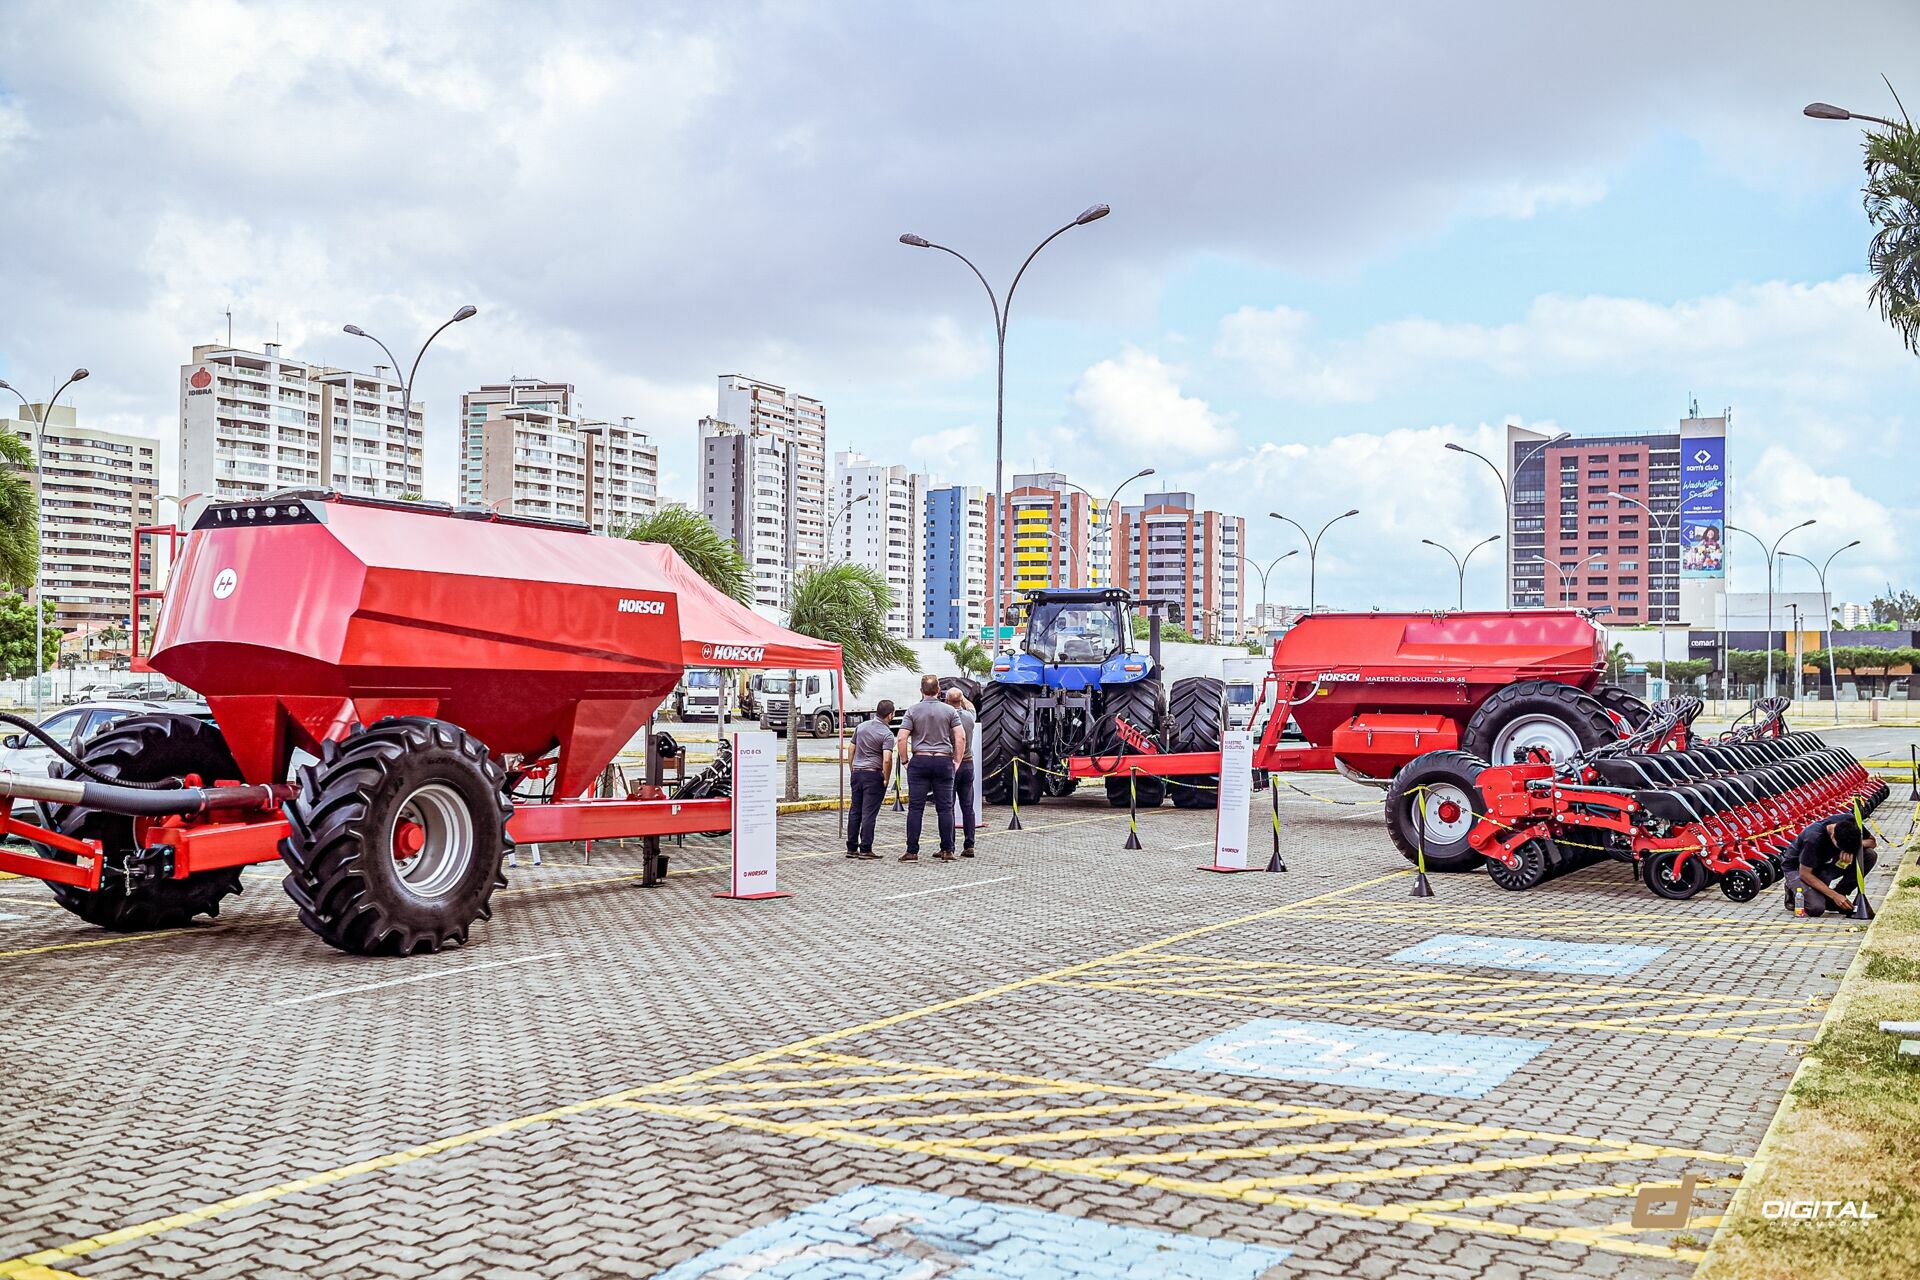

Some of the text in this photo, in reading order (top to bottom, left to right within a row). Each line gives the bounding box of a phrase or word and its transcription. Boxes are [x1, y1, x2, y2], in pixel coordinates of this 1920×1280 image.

[188, 388, 212, 396] IDIBRA
[1704, 463, 1719, 471] club
[618, 599, 665, 614] HORSCH
[713, 645, 764, 662] HORSCH
[1318, 673, 1361, 682] HORSCH
[747, 869, 769, 877] HORSCH
